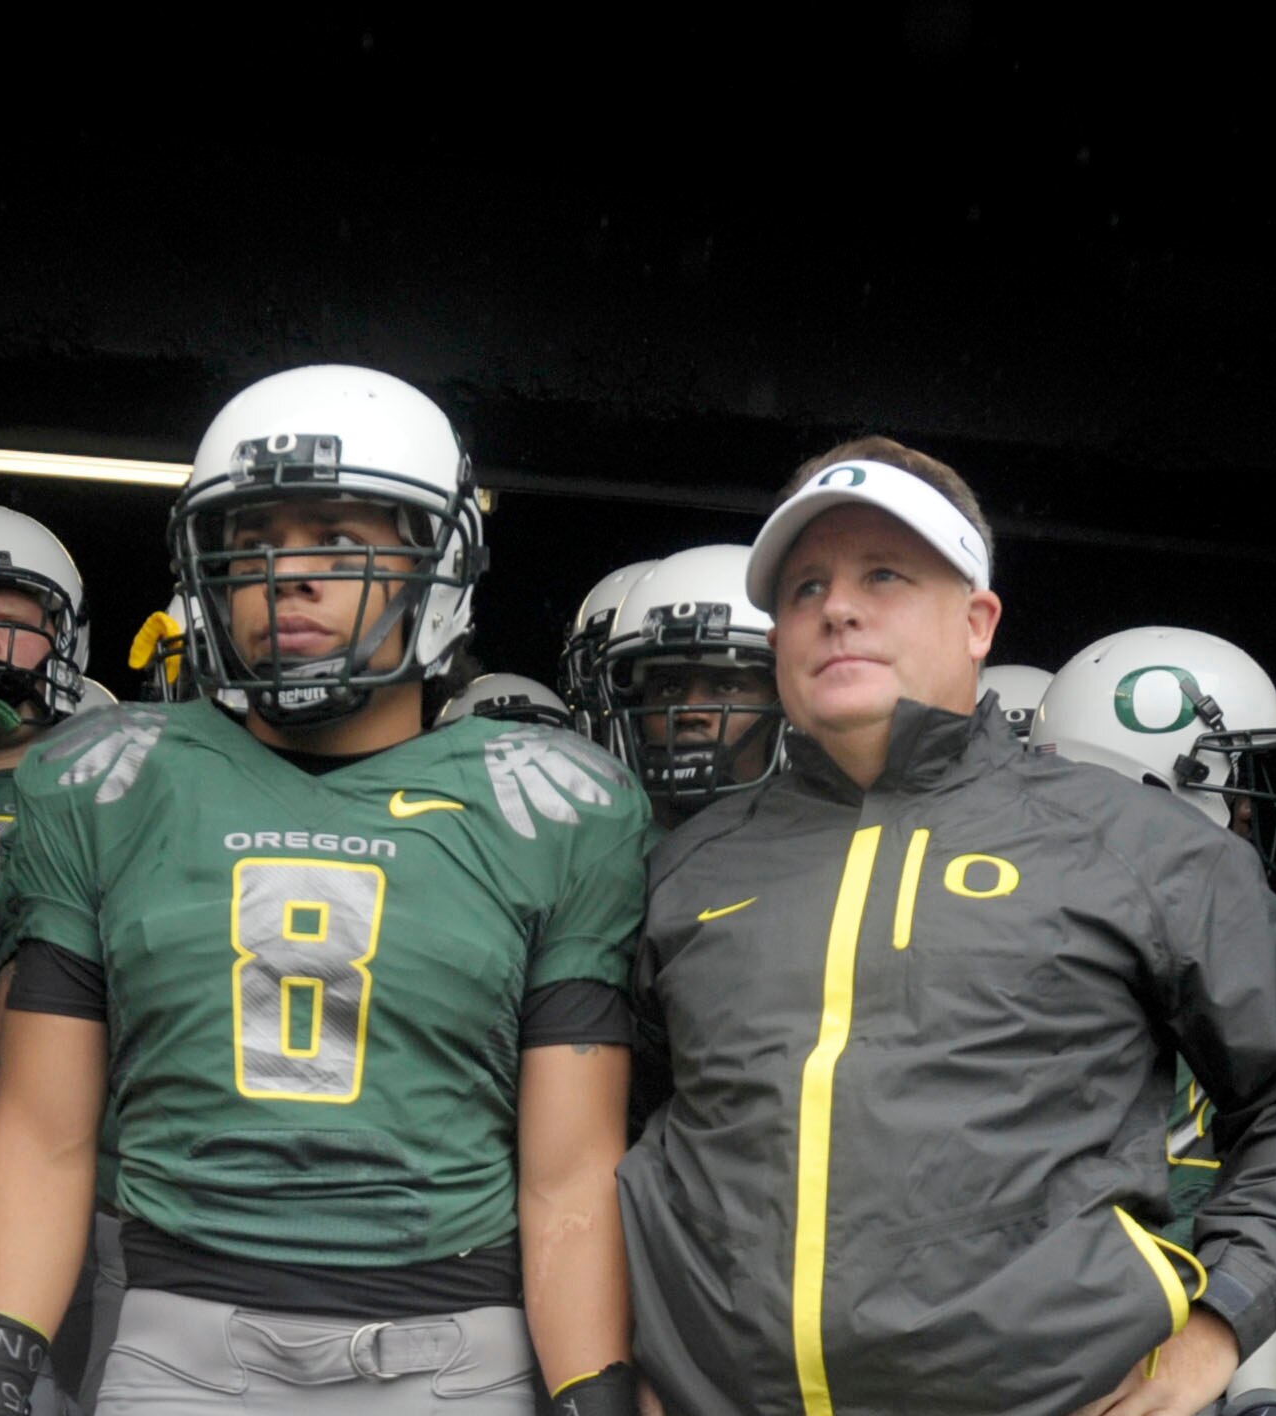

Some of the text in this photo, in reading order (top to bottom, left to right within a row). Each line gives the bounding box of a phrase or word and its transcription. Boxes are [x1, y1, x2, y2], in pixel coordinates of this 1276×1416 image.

[267, 434, 297, 453] O
[672, 602, 696, 618] O
[1114, 665, 1200, 734] O
[1006, 709, 1026, 722] O
[224, 832, 397, 857] OREGON
[944, 853, 1020, 899] O
[231, 856, 387, 1104] 8
